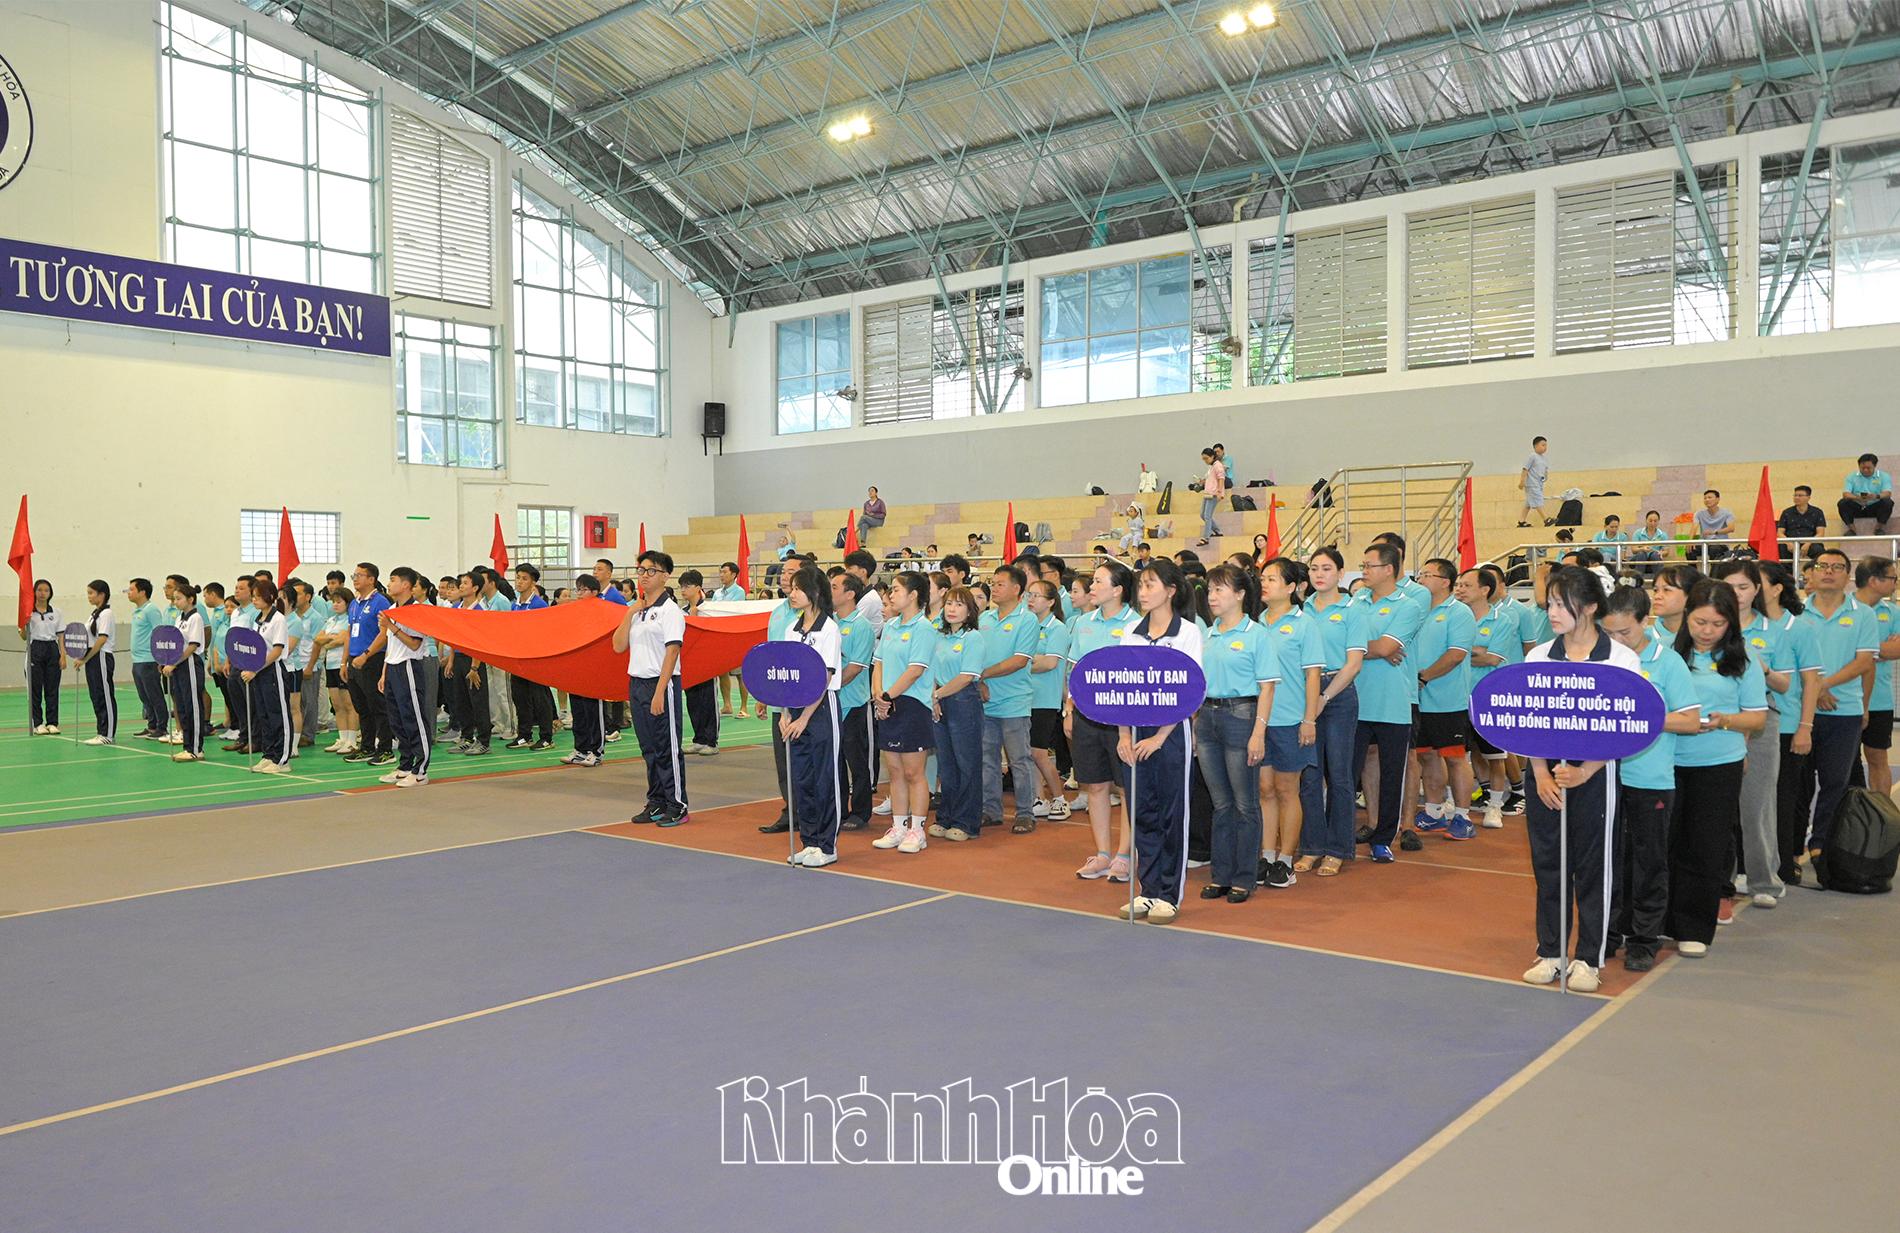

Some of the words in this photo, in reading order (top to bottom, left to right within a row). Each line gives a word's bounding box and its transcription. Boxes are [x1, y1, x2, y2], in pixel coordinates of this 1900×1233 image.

[9, 256, 146, 314] TƯƠNG
[154, 277, 214, 322] LAI
[221, 280, 289, 334] CỦA
[294, 297, 364, 346] BẠN!
[767, 666, 776, 680] SỞ
[777, 667, 789, 683] NỘI
[790, 670, 800, 683] VỤ
[1085, 668, 1106, 684] VĂN
[1108, 668, 1144, 684] PHÒNG
[1147, 666, 1161, 684] ỦY
[1164, 670, 1188, 684] BAN
[1527, 673, 1551, 689] VĂN
[1554, 674, 1595, 690] PHÒNG
[1095, 689, 1124, 705] NHÂN
[1127, 689, 1150, 705] DÂN
[1152, 688, 1178, 706] TỈNH
[1490, 694, 1522, 708] ĐOÀN
[1524, 696, 1544, 711] ĐẠI
[1548, 692, 1575, 710] BIỂU
[1578, 694, 1610, 712] QUỐC
[1614, 696, 1636, 715] HỘI
[1480, 711, 1494, 726] VÀ
[1496, 713, 1516, 730] HỘI
[1518, 712, 1550, 729] ĐỒNG
[1554, 714, 1588, 731] NHÂN
[1590, 717, 1616, 732] DÂN
[1620, 716, 1648, 734] TỈNH
